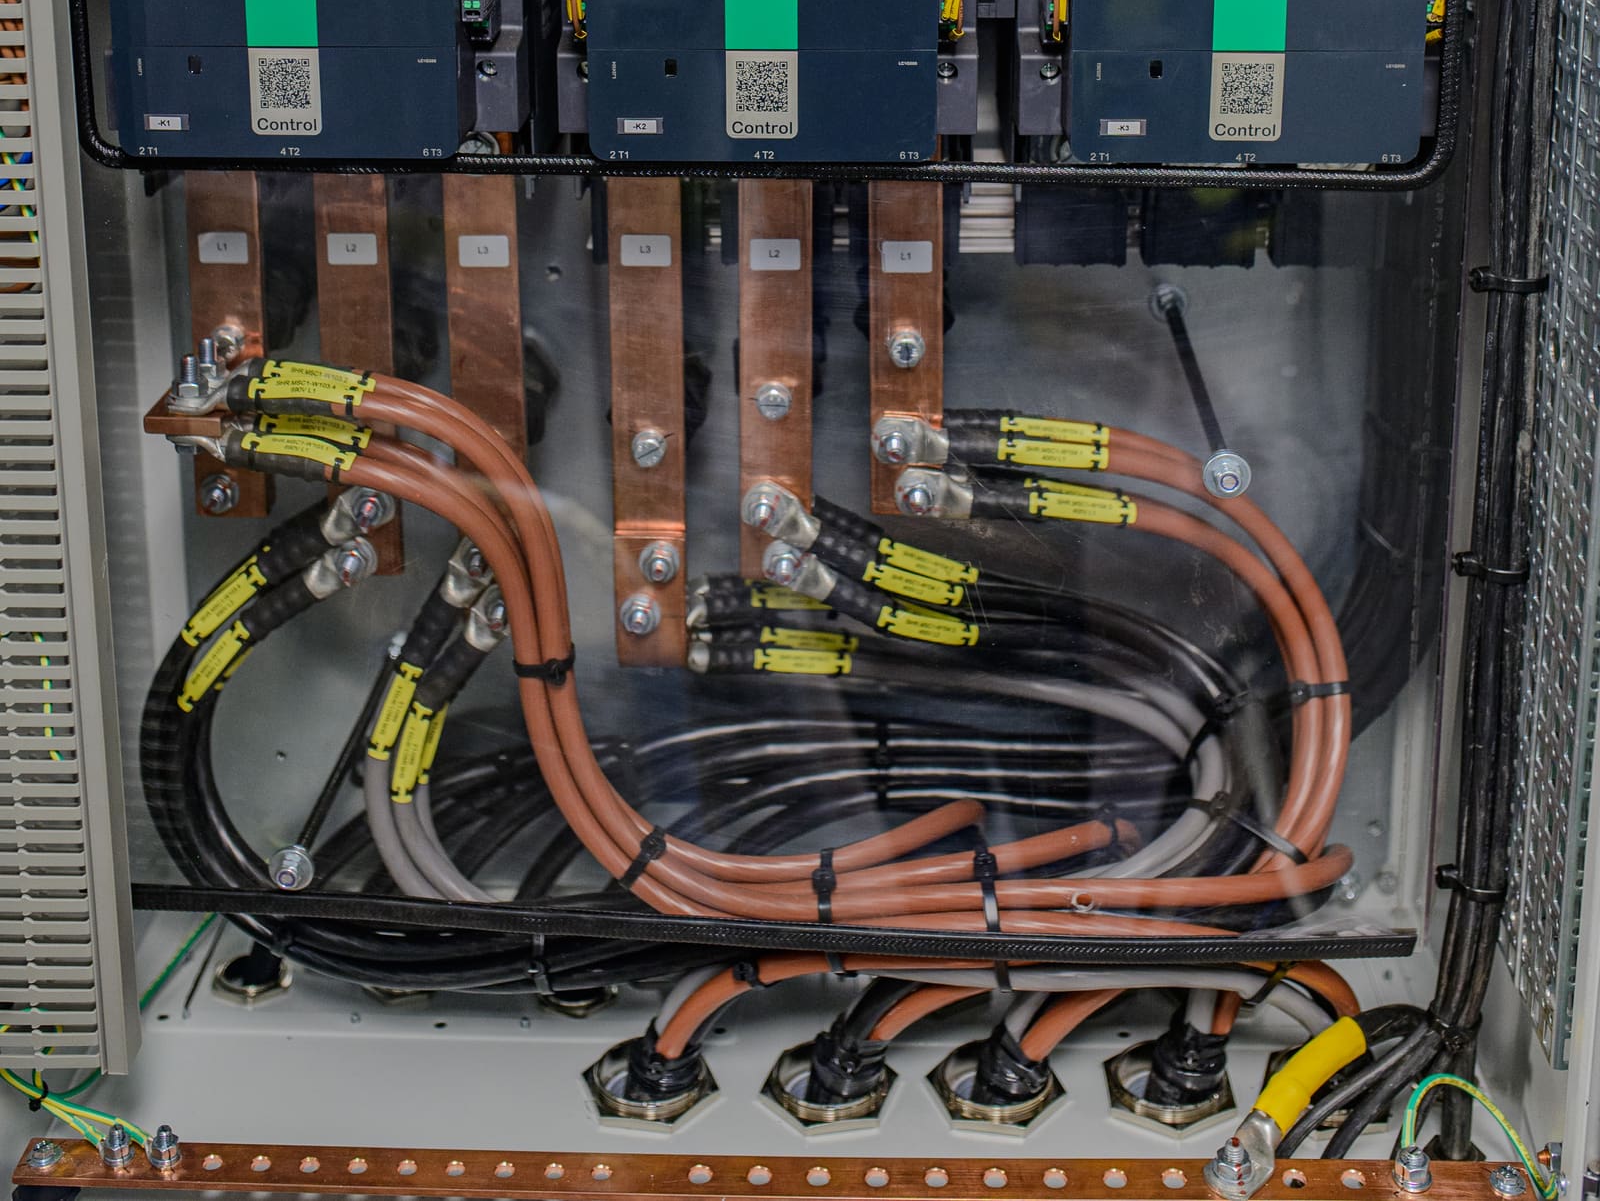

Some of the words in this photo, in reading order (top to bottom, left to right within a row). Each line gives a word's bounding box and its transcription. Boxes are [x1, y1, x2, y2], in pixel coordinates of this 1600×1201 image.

[157, 119, 171, 127] -K1
[257, 117, 317, 132] Control
[632, 122, 647, 130] -K2
[731, 120, 793, 135] Control
[1214, 123, 1276, 137] Control
[147, 146, 158, 156] T1
[287, 147, 301, 156] T2
[430, 148, 442, 157] T3
[617, 150, 629, 160] T1
[761, 150, 775, 160] T2
[907, 151, 920, 160] T3
[1098, 152, 1111, 162] T1
[1243, 152, 1256, 162] T2
[1389, 153, 1402, 163] T3
[216, 242, 228, 252] L1
[345, 243, 357, 253] L2
[477, 245, 489, 255] L3
[639, 244, 652, 255] L3
[768, 248, 781, 259] L2
[900, 251, 912, 261] L1
